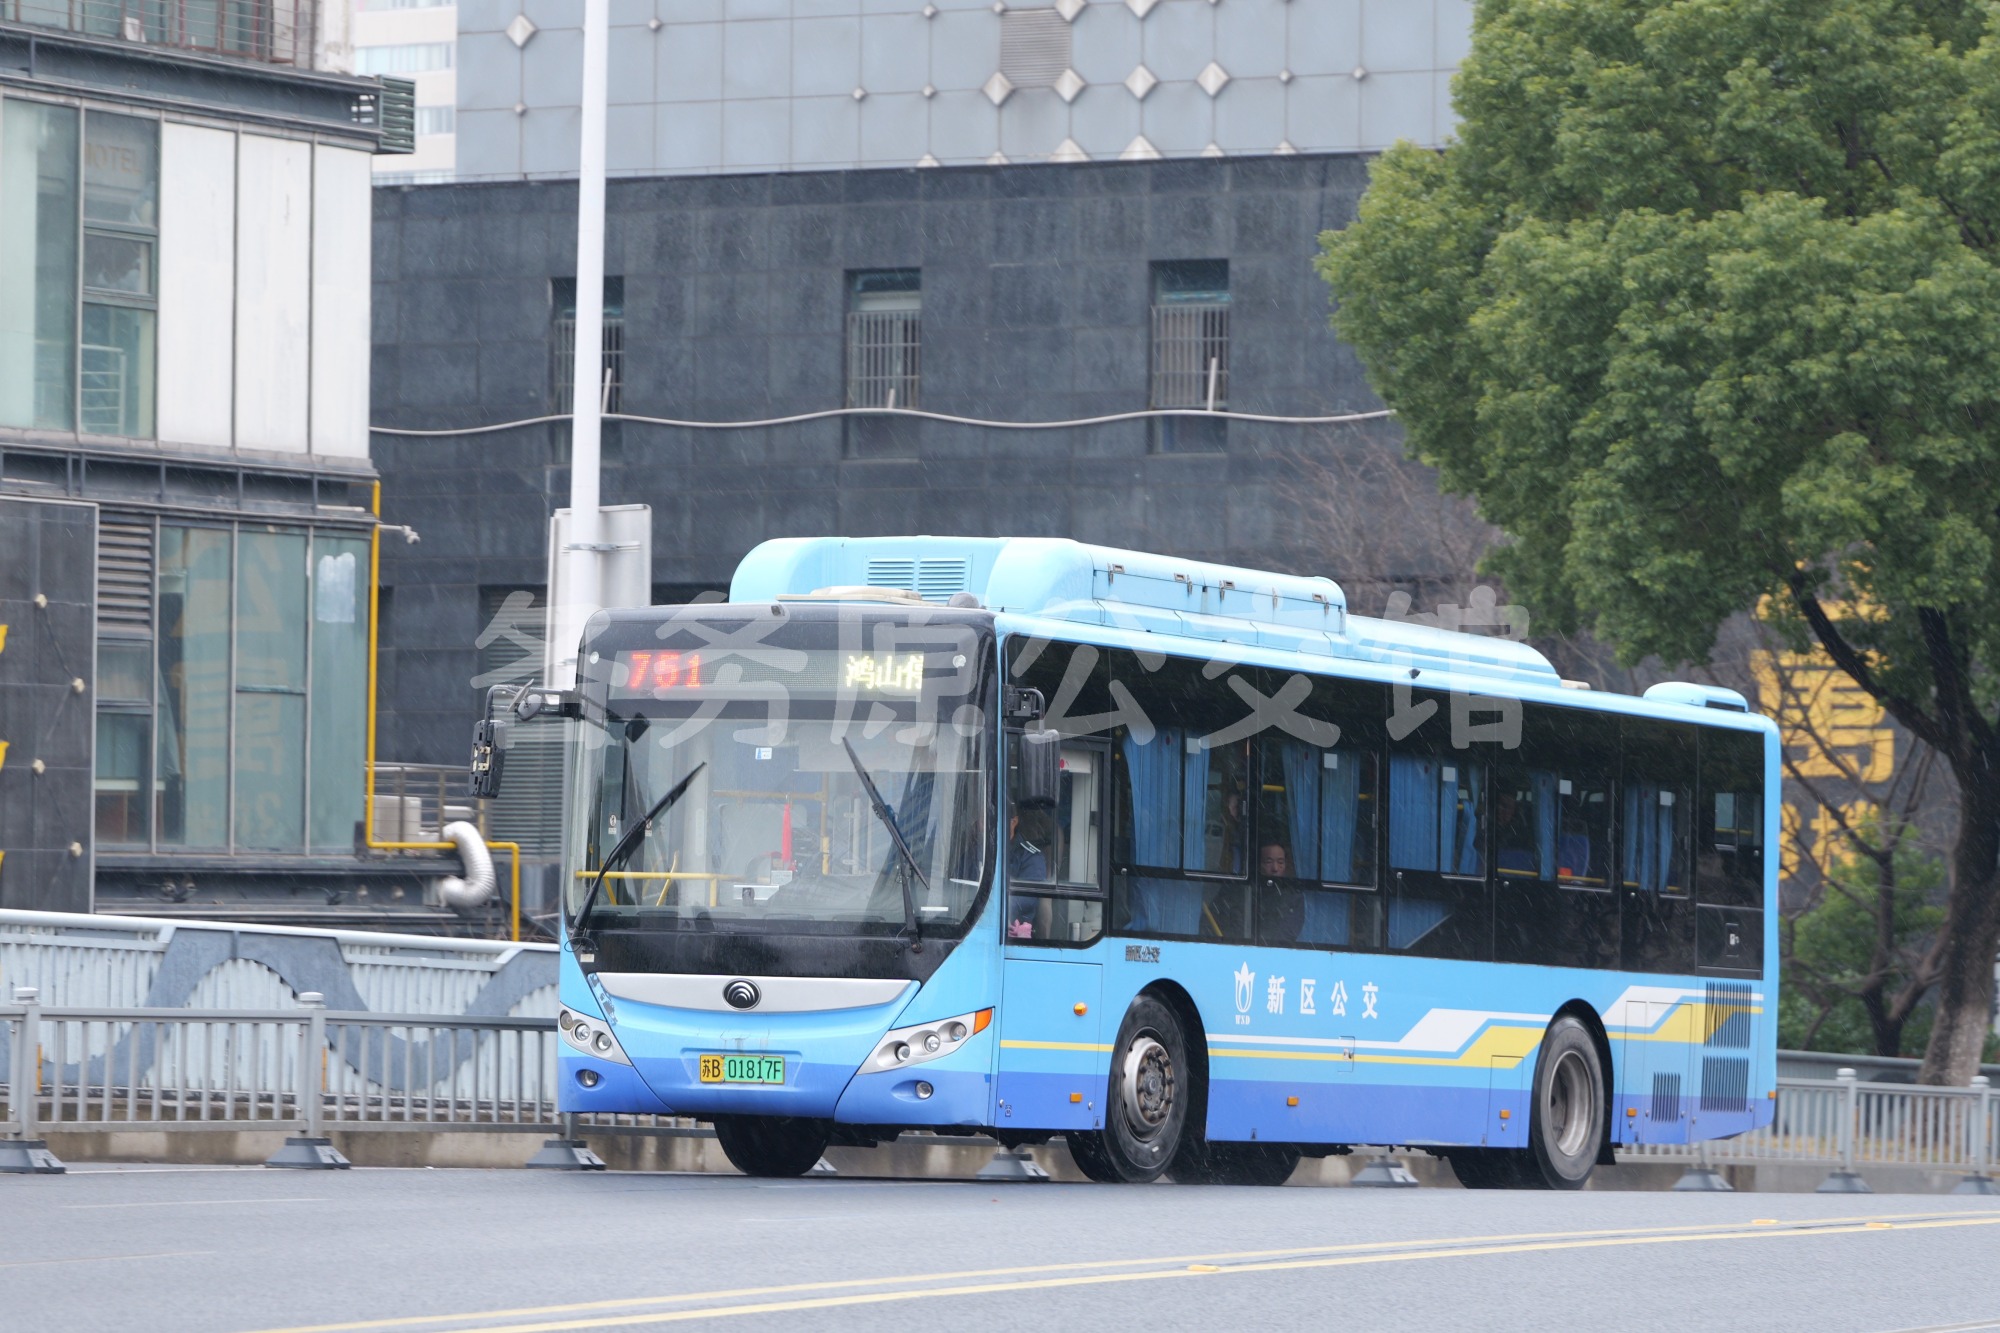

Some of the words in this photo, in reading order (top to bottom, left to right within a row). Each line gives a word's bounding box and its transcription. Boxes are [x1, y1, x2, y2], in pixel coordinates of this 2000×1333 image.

[630, 653, 701, 688] 751
[1267, 974, 1379, 1020] 新区公交
